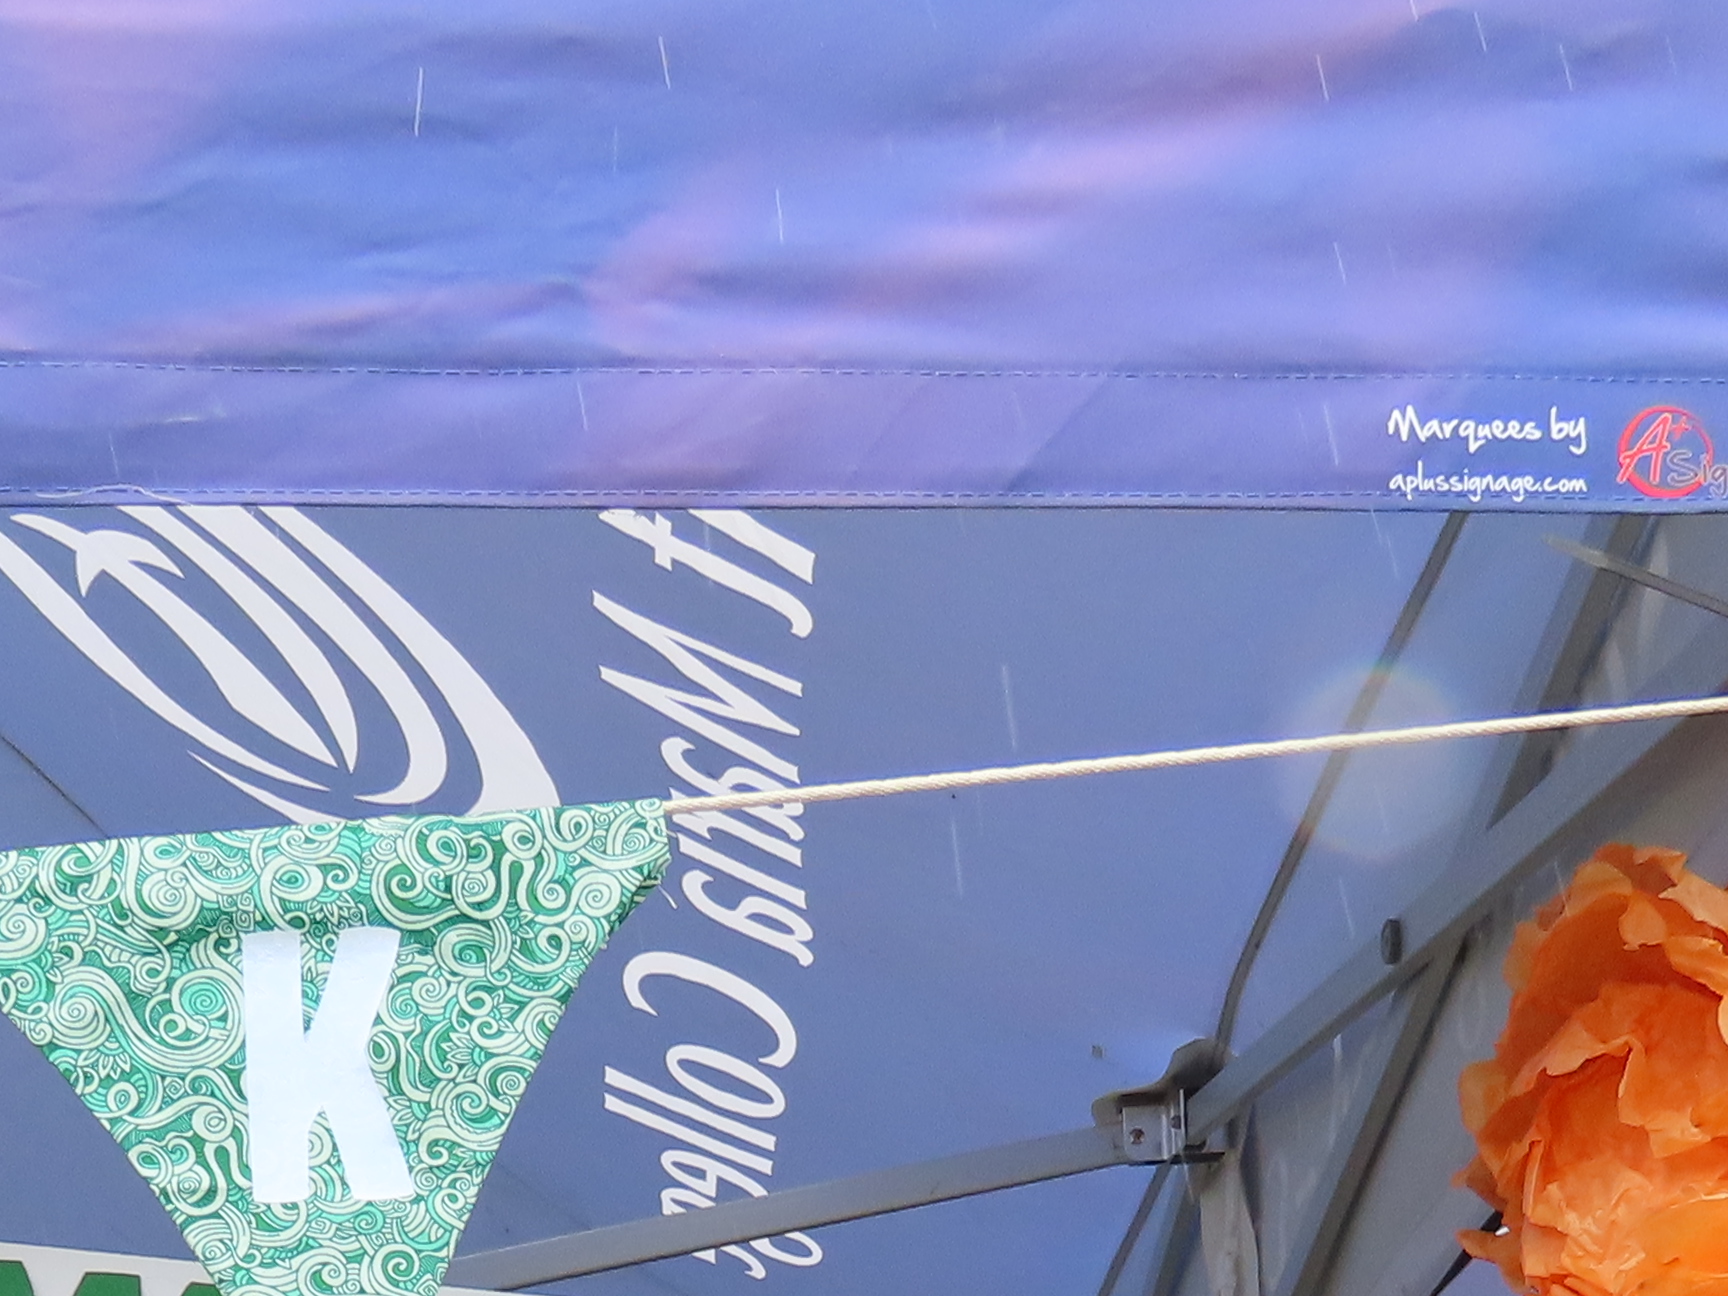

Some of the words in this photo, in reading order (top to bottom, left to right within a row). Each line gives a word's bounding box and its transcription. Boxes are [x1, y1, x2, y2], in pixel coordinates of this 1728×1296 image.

[1387, 404, 1543, 454] Marquees
[1550, 405, 1588, 455] by
[1388, 459, 1588, 503] aplussignage.com
